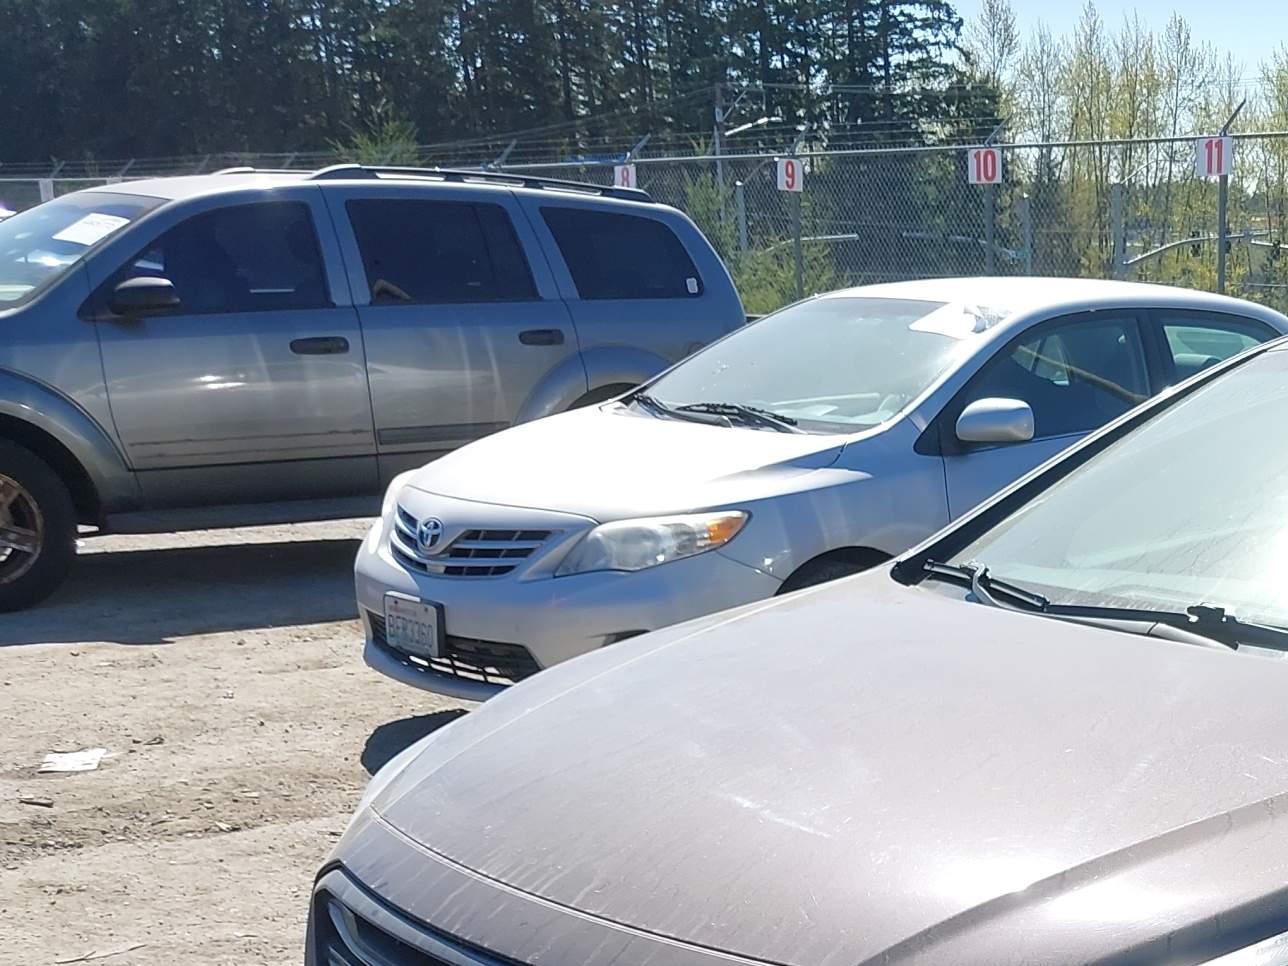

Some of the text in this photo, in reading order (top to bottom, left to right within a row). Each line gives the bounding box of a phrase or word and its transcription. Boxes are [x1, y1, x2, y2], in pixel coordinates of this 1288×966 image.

[973, 149, 997, 182] 10
[1204, 139, 1224, 174] 11
[620, 167, 630, 187] 8
[784, 160, 796, 190] 9
